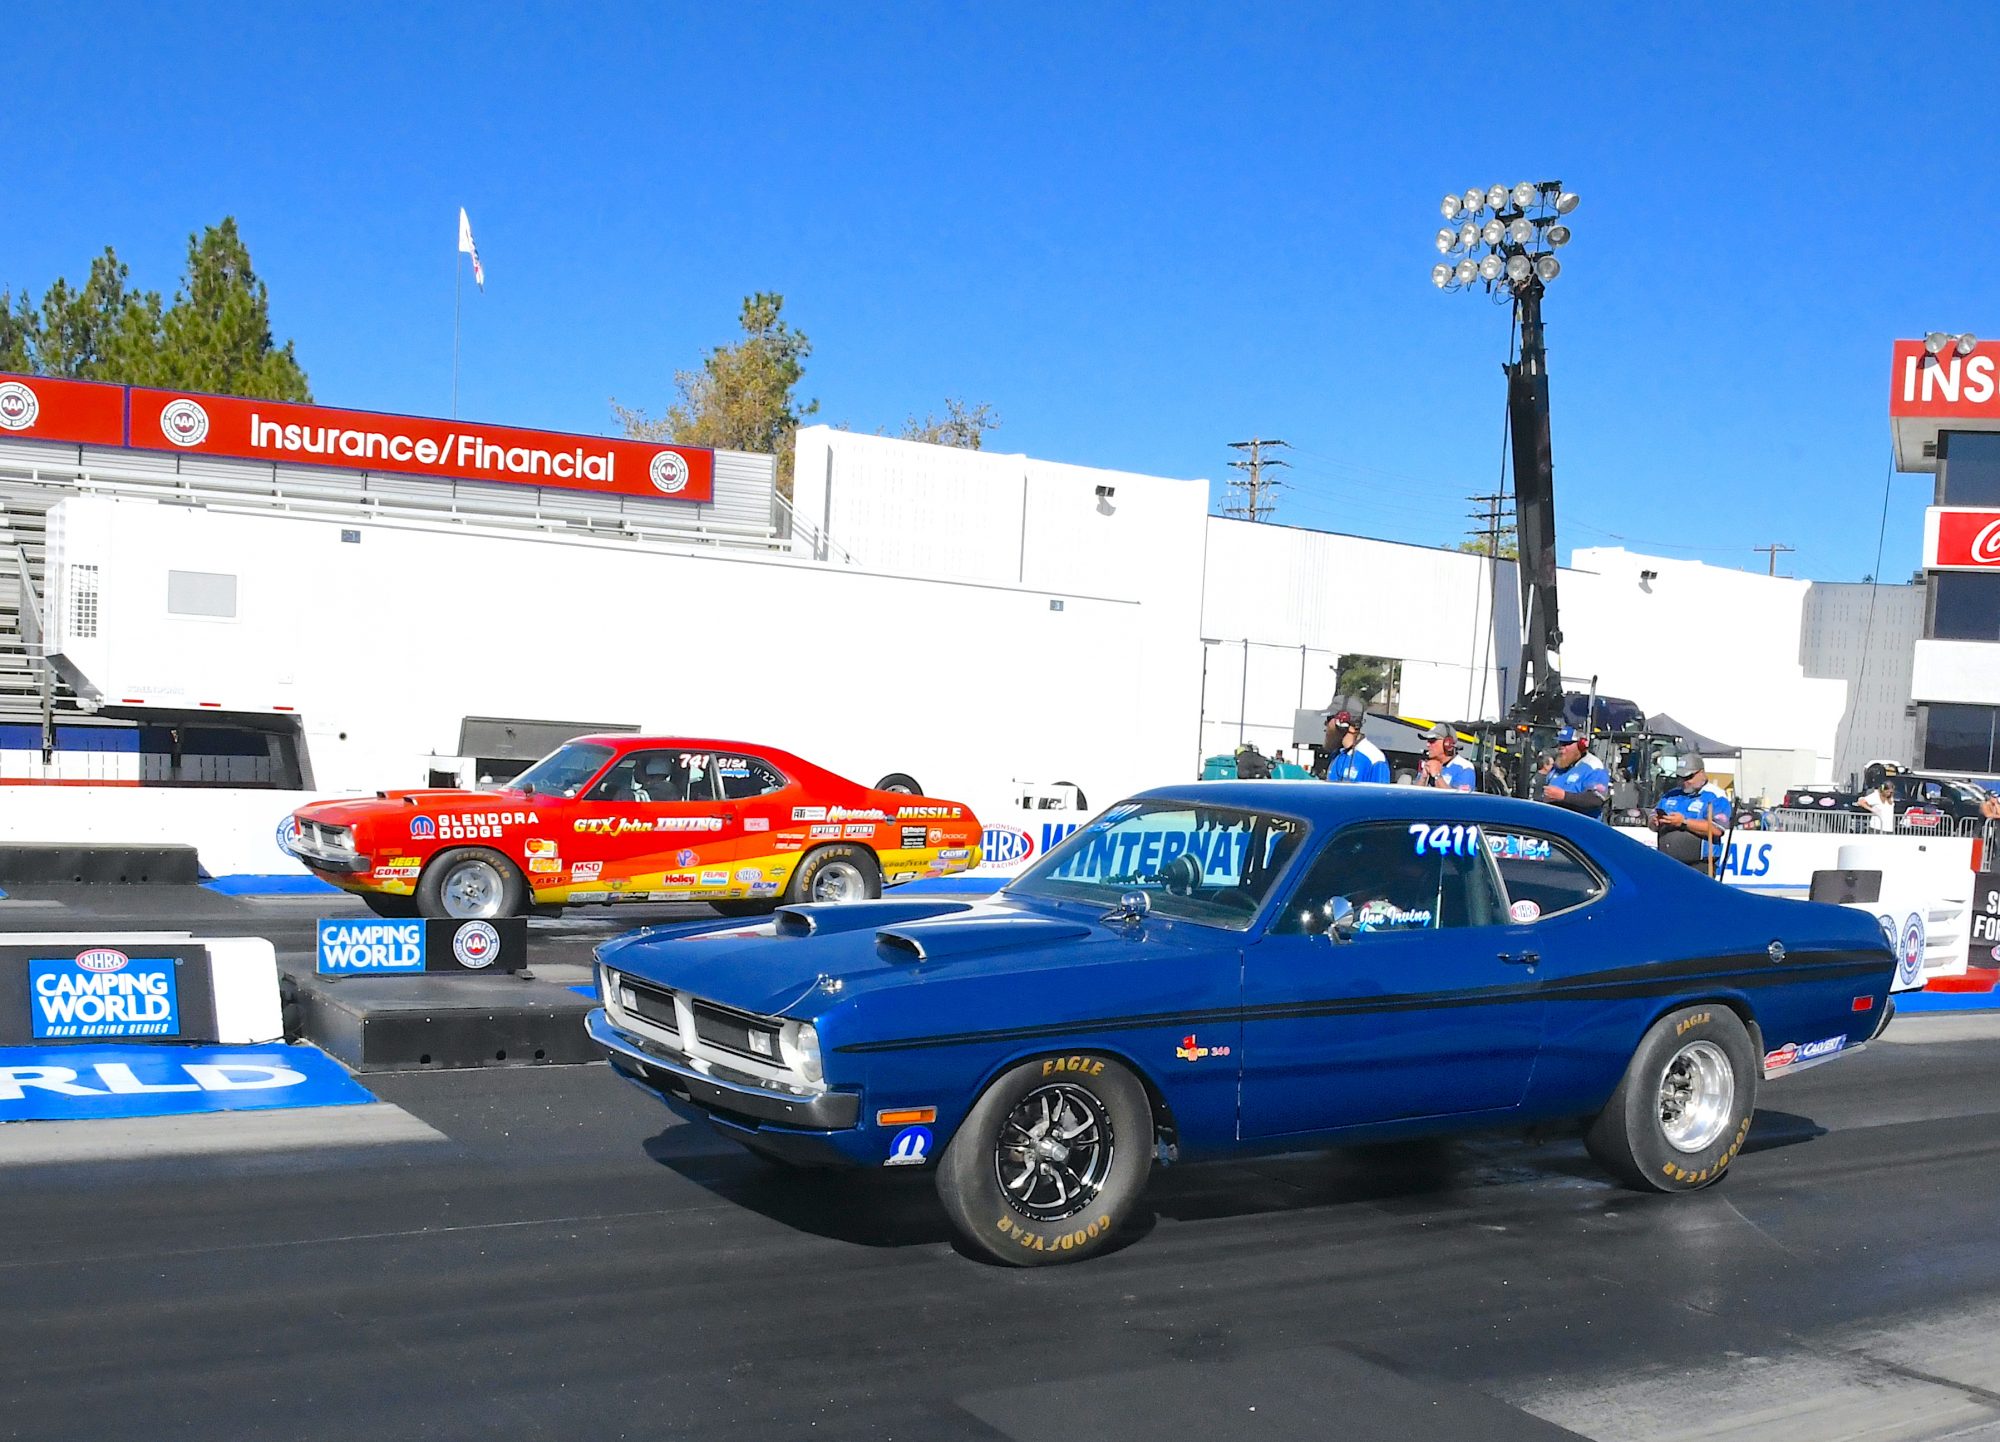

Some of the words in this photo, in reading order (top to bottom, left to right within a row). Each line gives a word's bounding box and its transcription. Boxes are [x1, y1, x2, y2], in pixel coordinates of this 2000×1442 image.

[2, 398, 24, 412] AAA
[174, 415, 195, 428] AAA
[250, 413, 615, 482] Insurance/Financial
[661, 465, 677, 477] AAA
[680, 753, 710, 769] 741
[438, 812, 539, 828] GLENDORA
[826, 805, 886, 823] Nevada
[896, 806, 962, 819] MISSILE
[439, 825, 503, 840] DODGE
[573, 817, 616, 835] GTX
[613, 818, 653, 837] John
[653, 817, 723, 832] IRVING
[812, 826, 841, 835] OPTIMA
[846, 825, 874, 833] OPTIMA
[983, 830, 1024, 860] HRA
[1409, 824, 1478, 857] 7411
[389, 857, 421, 867] JEGS
[575, 863, 601, 872] MSD
[801, 848, 852, 892] GOODYEAR
[991, 860, 1019, 869] RACING
[376, 868, 410, 876] COMP
[665, 874, 695, 885] Holley
[1360, 907, 1384, 932] Jon
[1386, 905, 1432, 927] Irving
[322, 925, 421, 946] CAMPING
[466, 935, 487, 950] AAA
[81, 952, 123, 969] NHRA
[323, 944, 422, 968] WORLD
[36, 972, 169, 997] CAMPING
[38, 994, 172, 1024] WORLD
[46, 1025, 77, 1036] DRAG
[81, 1024, 124, 1036] RACING
[128, 1023, 169, 1035] SERIES
[1676, 1012, 1711, 1037] EAGLE
[1803, 1035, 1843, 1056] CALVERT
[1042, 1055, 1105, 1077] EAGLE
[1663, 1117, 1749, 1183] GOODYEAR
[996, 1213, 1111, 1251] GOODYEAR
